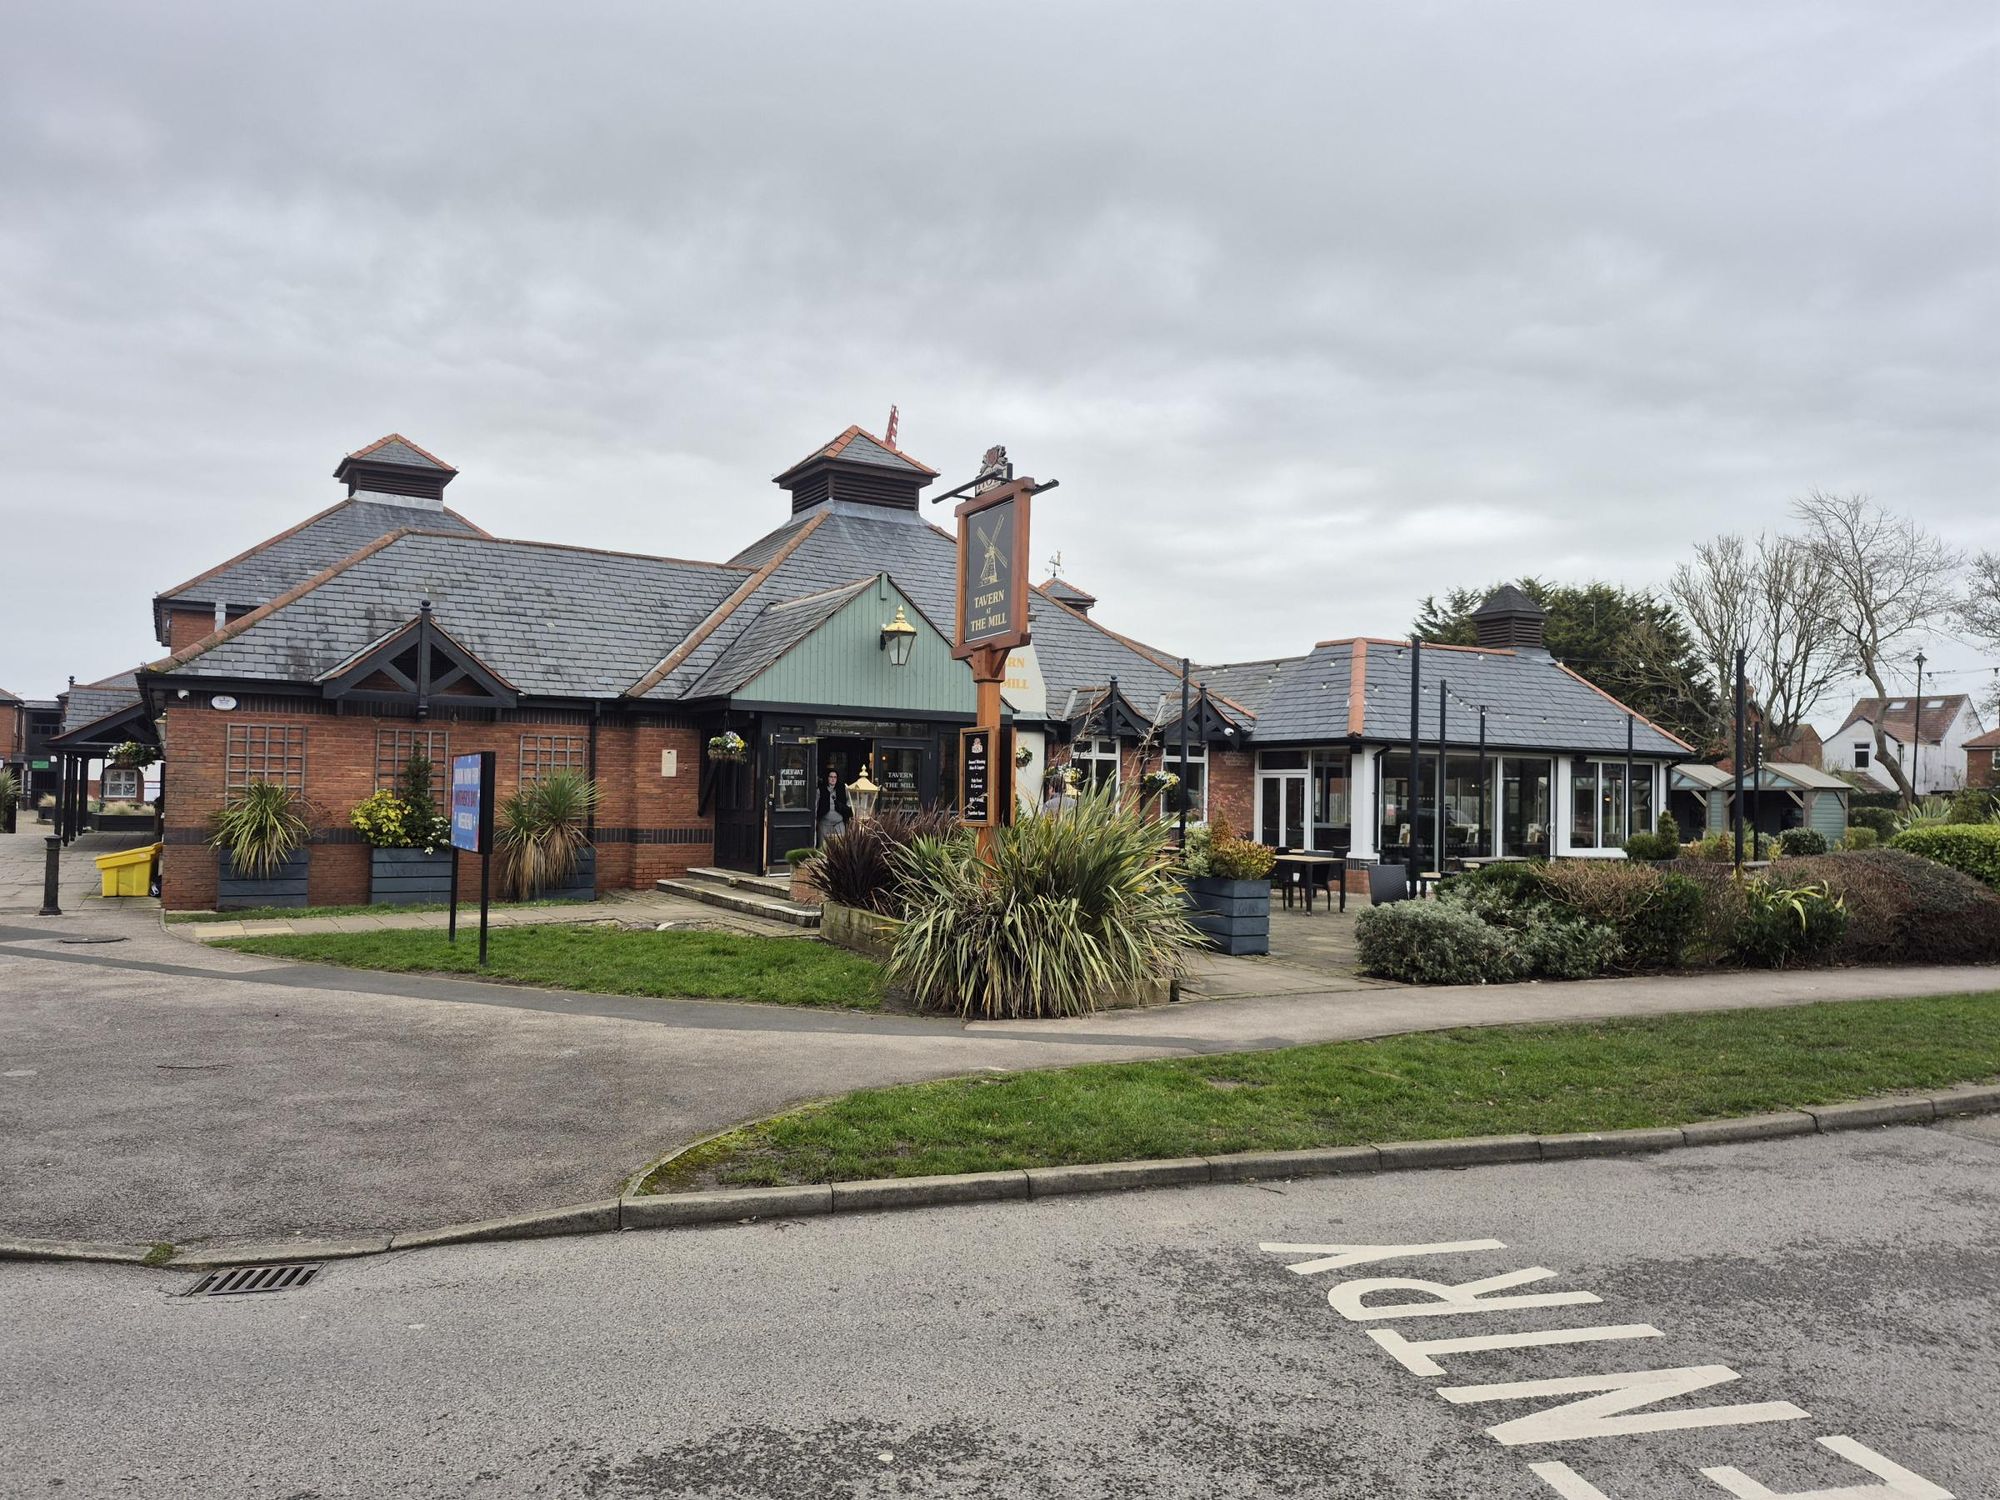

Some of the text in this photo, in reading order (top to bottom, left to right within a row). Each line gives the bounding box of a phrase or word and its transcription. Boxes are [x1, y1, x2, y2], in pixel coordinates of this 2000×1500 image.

[974, 590, 1005, 608] TAVERN
[971, 613, 1007, 632] THE MILL
[1258, 1238, 1956, 1500] ENTRY
